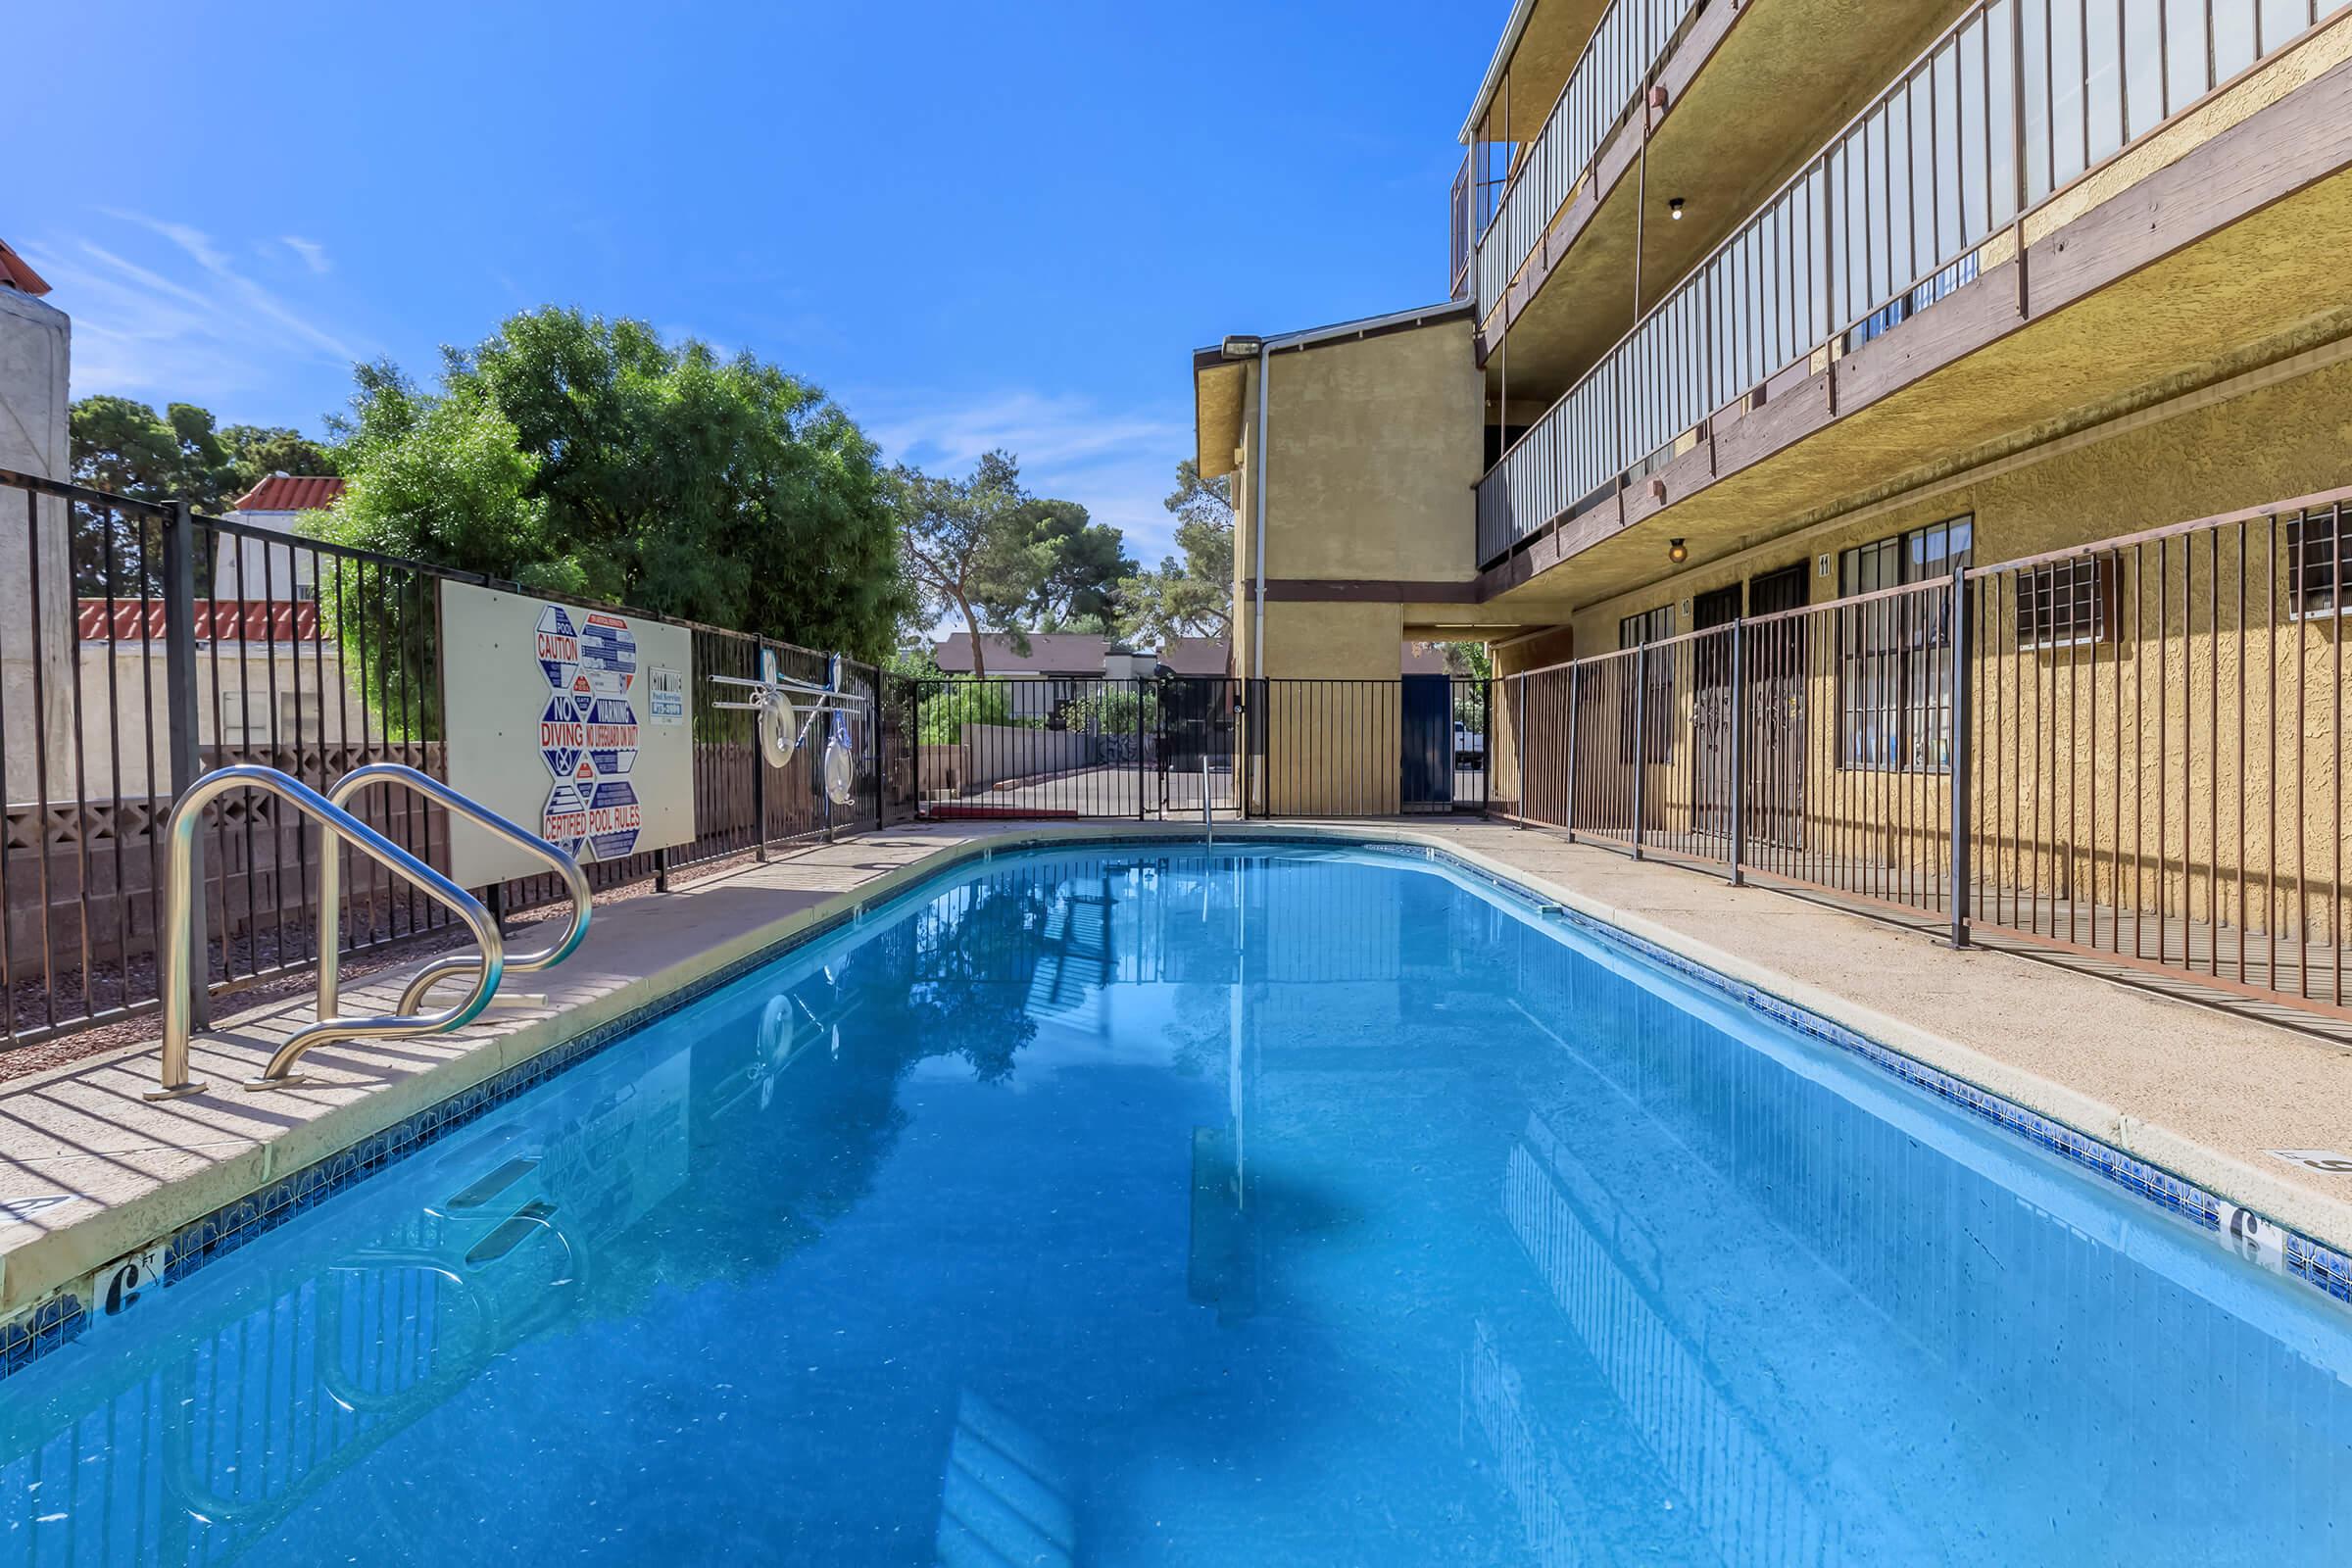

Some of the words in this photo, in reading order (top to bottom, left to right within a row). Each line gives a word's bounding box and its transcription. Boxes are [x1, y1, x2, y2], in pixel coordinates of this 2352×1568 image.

[1821, 556, 1829, 576] 11
[557, 622, 573, 636] POOL
[538, 633, 578, 662] CAUTION
[554, 697, 572, 721] NO
[597, 699, 630, 723] WARNING
[541, 723, 583, 747] DIVING
[545, 812, 587, 841] CERTIFIED
[589, 808, 612, 833] POOL
[614, 806, 641, 829] RULES
